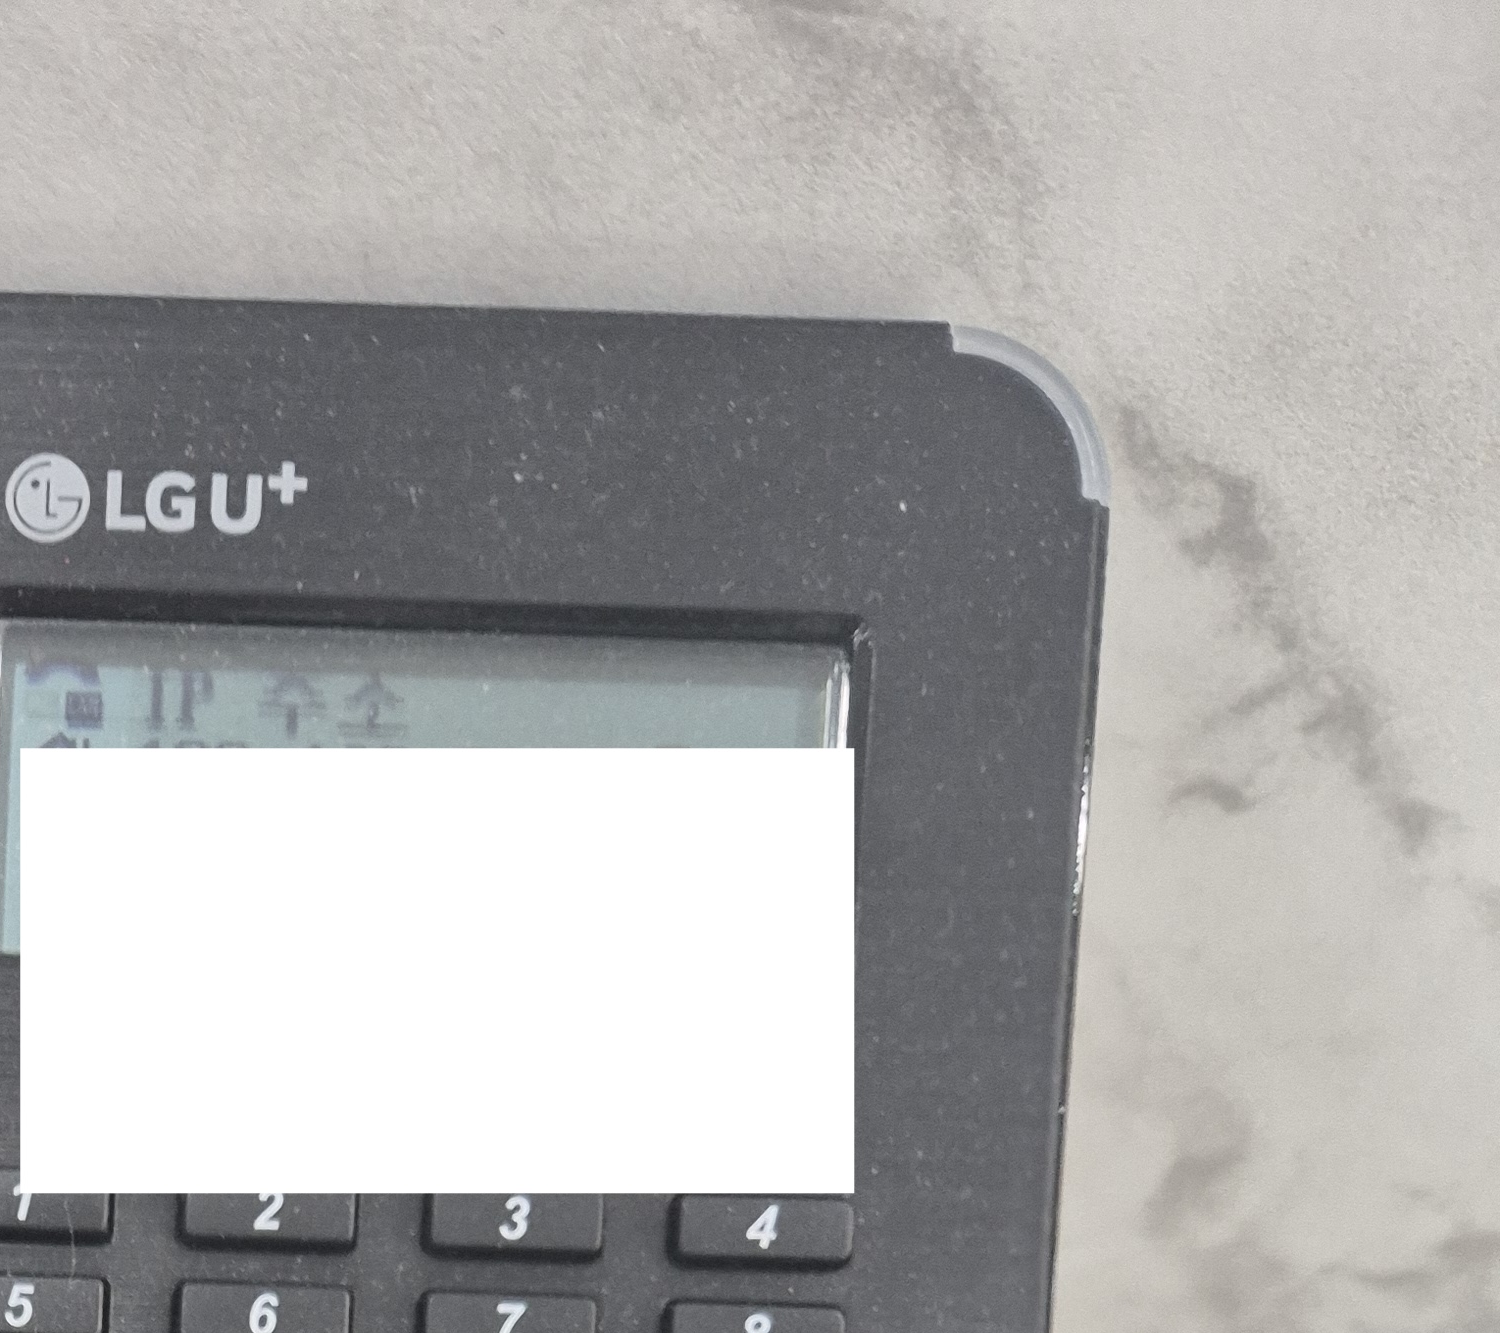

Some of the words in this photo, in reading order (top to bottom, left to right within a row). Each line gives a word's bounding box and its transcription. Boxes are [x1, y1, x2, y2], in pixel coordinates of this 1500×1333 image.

[13, 1183, 32, 1221] 1
[254, 1193, 284, 1230] 2
[499, 1195, 530, 1240] 3
[746, 1205, 779, 1249] 4
[5, 1283, 34, 1327] 5
